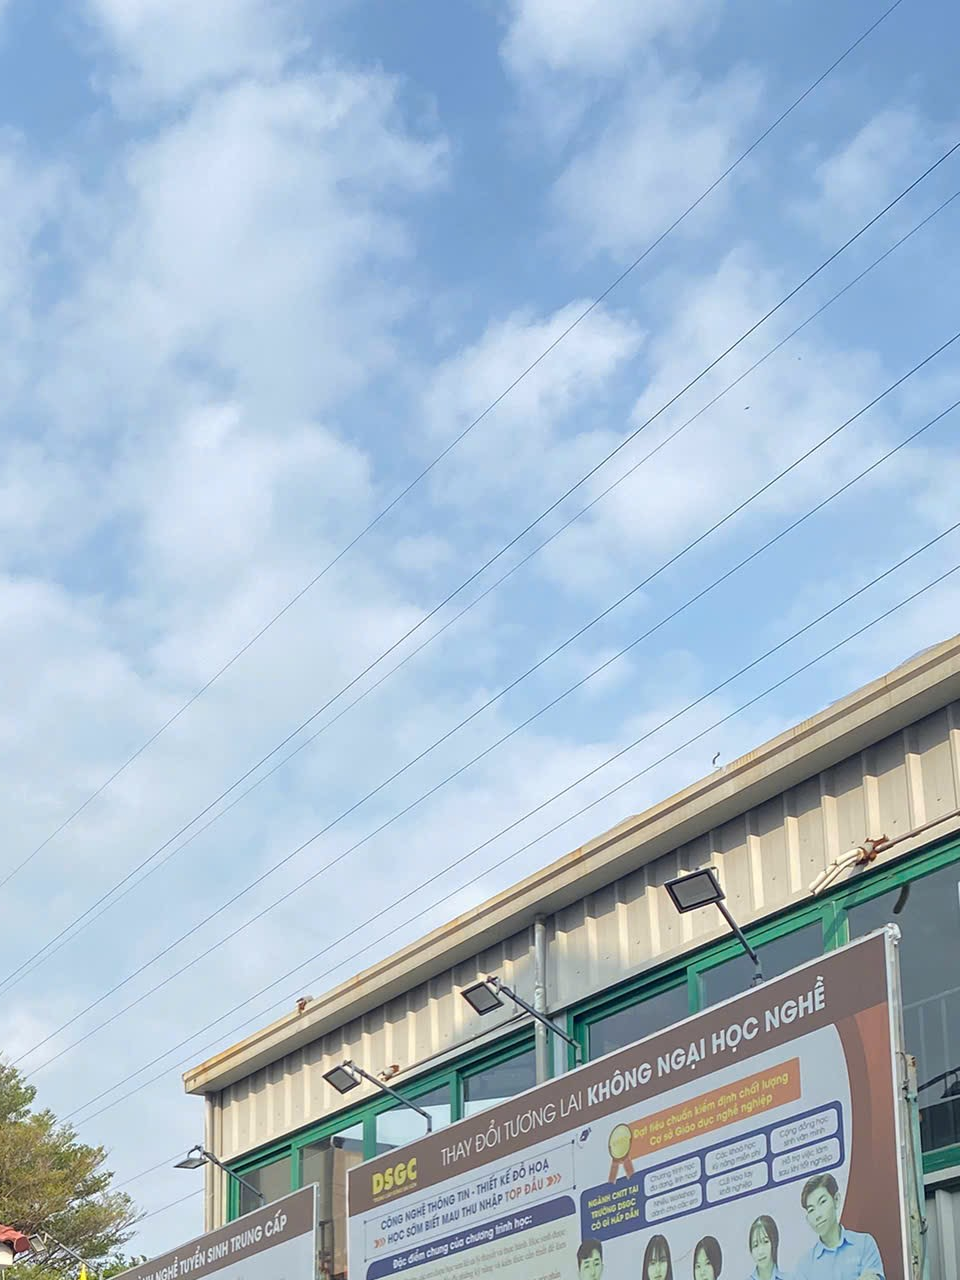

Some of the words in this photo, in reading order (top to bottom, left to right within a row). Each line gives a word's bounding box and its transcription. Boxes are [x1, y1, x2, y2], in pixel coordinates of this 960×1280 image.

[441, 1138, 472, 1166] THAY
[475, 1119, 501, 1152] ĐỔI
[504, 1104, 556, 1138] TƯƠNG
[560, 1091, 583, 1118] LAI
[587, 1063, 652, 1106] KHÔNG
[657, 1038, 706, 1077] NGẠI
[711, 1016, 759, 1055] HỌC
[765, 975, 826, 1032] NGHỀ
[372, 1157, 417, 1195] DSGC
[381, 1211, 404, 1230] CÔNG
[405, 1204, 427, 1223] NGHỆ
[427, 1192, 456, 1214] THÔNG
[457, 1187, 470, 1203] TIN
[476, 1175, 499, 1198] THIẾT
[500, 1168, 512, 1188] KẾ
[512, 1161, 527, 1182] ĐỒ
[387, 1230, 405, 1245] HỌC
[442, 1210, 460, 1228] MAU
[461, 1204, 477, 1220] THU
[479, 1193, 503, 1215] NHẬP
[504, 1185, 522, 1201] TOP
[524, 1175, 544, 1196] ĐẦU
[179, 1246, 206, 1276] TUYỂN
[207, 1241, 229, 1266] SINH
[231, 1226, 262, 1253] TRUNG
[264, 1209, 287, 1240] CẤP
